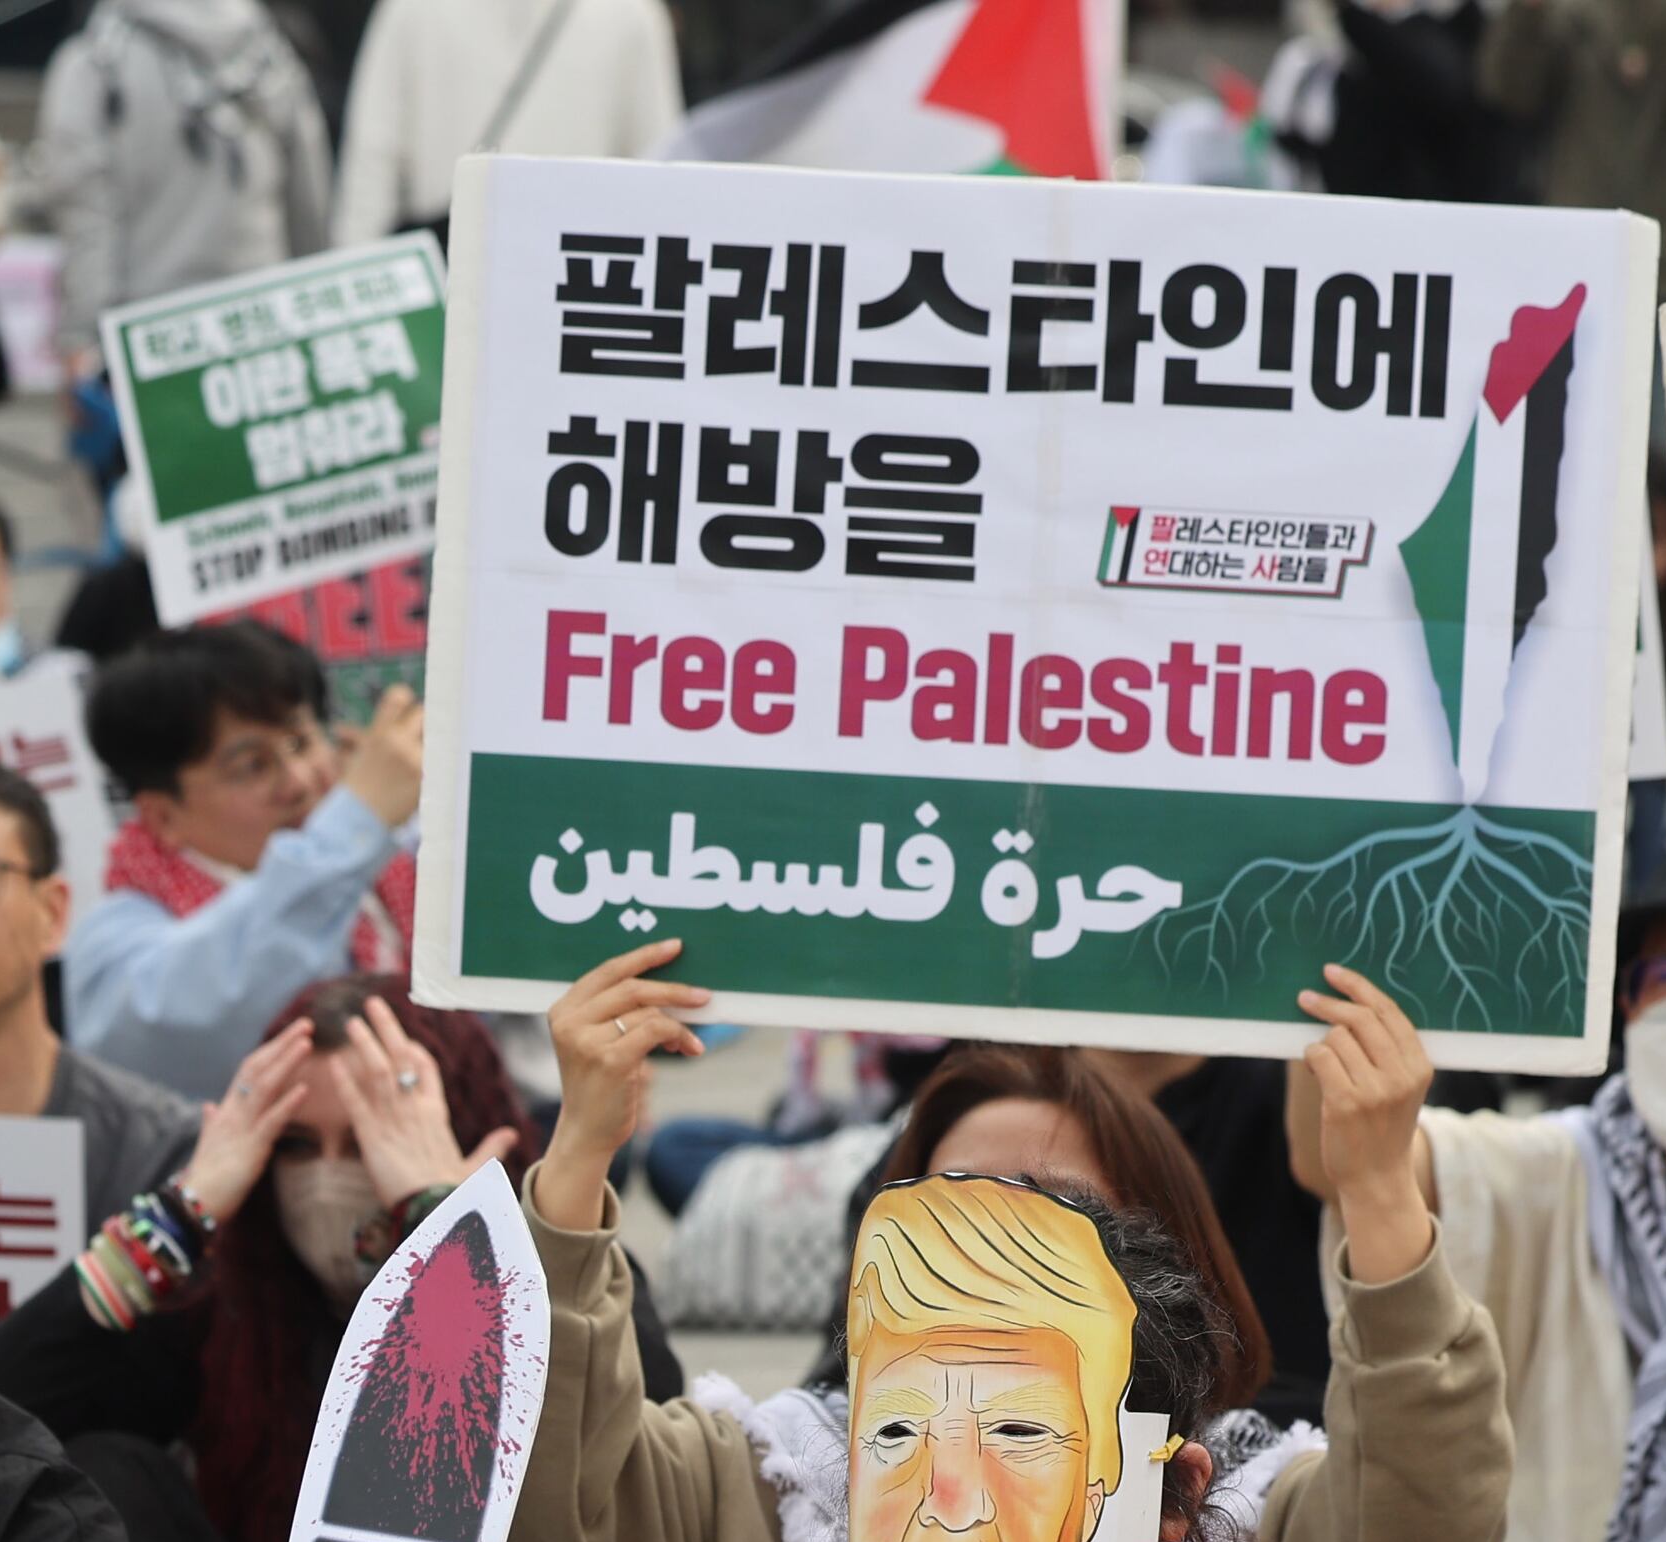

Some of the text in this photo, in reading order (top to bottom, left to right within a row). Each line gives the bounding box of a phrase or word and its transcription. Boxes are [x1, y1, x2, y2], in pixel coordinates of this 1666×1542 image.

[556, 233, 1452, 418] 팔레스타인에
[194, 545, 263, 591] STOP
[545, 416, 982, 581] 해방을
[1143, 548, 1327, 584] 연대하는 사람들
[1150, 514, 1357, 551] 팔레스타인인들과
[543, 610, 1387, 765] Free Palestine
[530, 802, 1182, 958] حرة فلسطين
